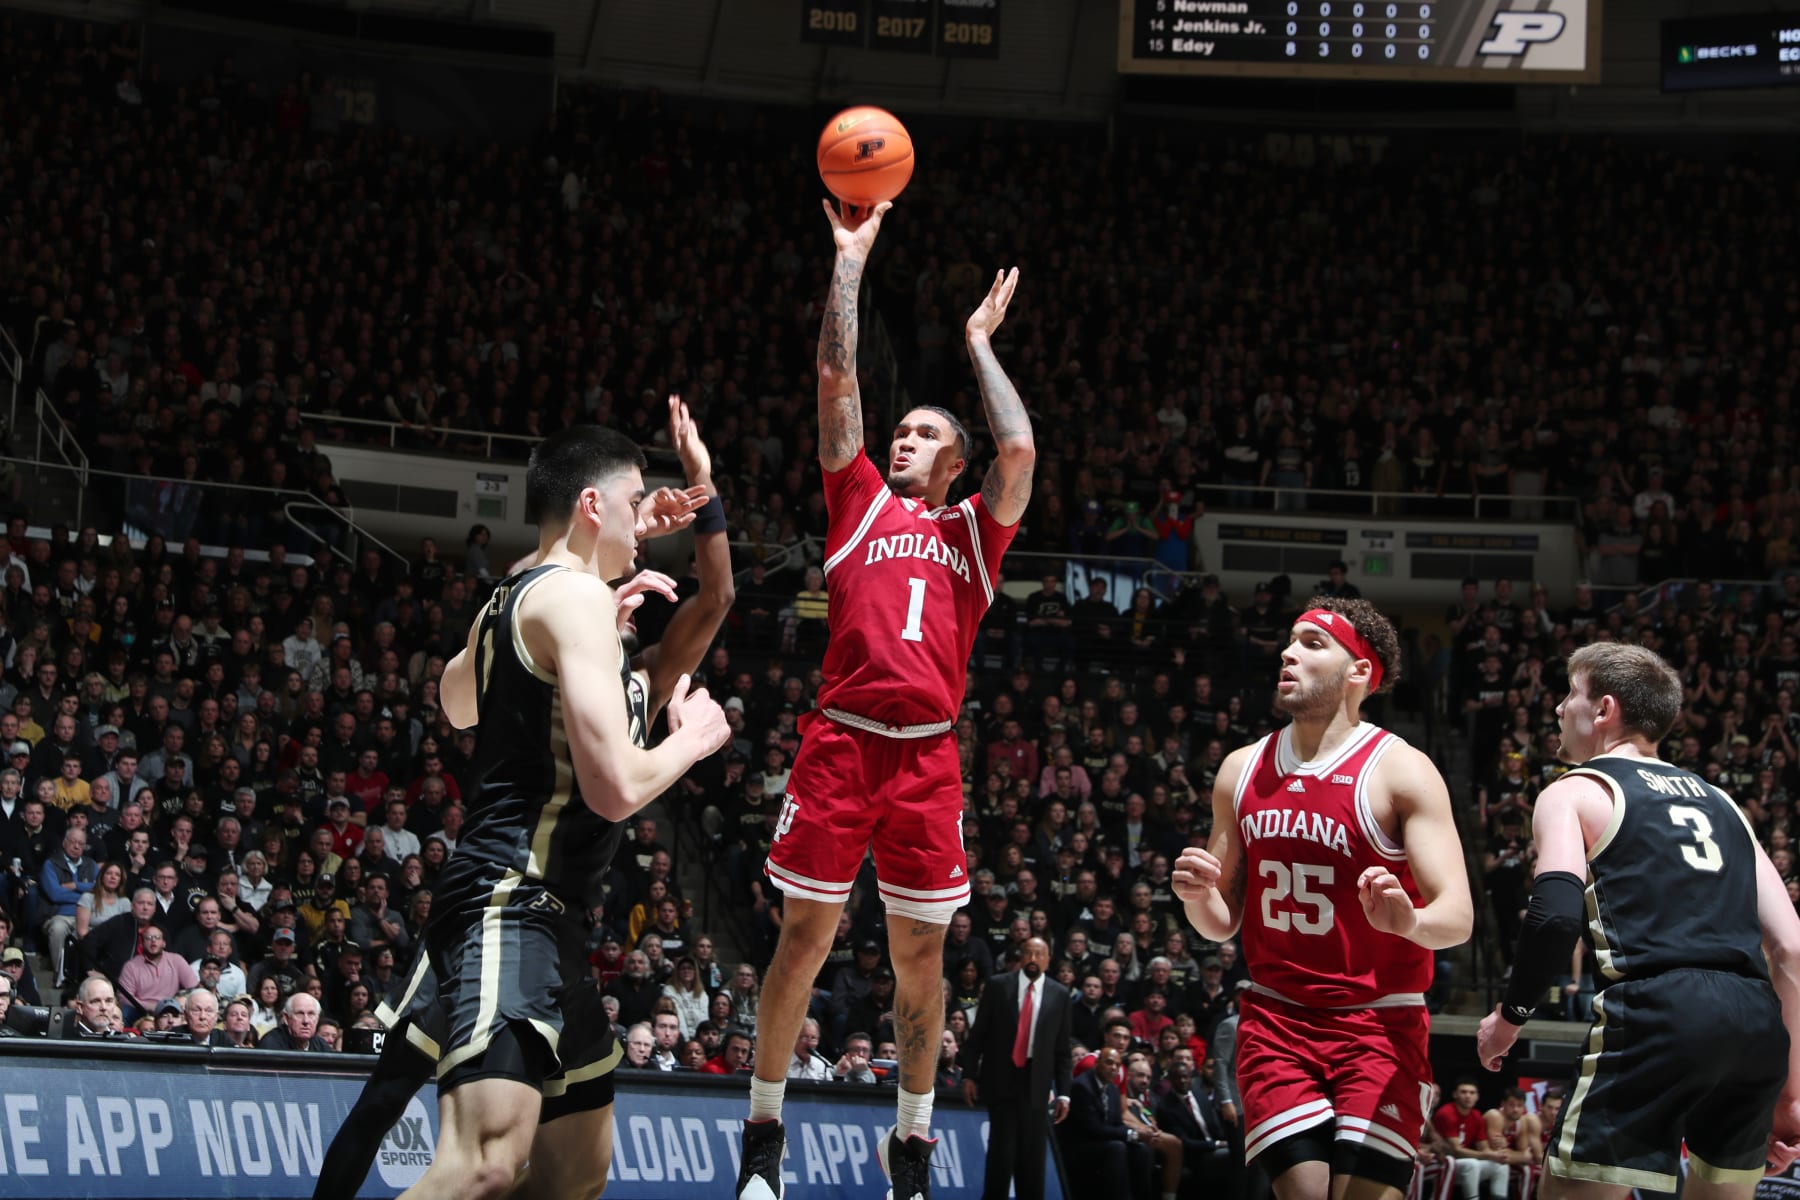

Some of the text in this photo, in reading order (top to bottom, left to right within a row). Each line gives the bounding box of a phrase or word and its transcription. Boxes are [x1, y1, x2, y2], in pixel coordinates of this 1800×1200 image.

[809, 8, 857, 31] 2010
[876, 16, 926, 38] 2017
[1174, 0, 1248, 13] Newman
[1287, 1, 1298, 16] 0
[1320, 2, 1331, 17] 0
[1353, 3, 1364, 18] 0
[1386, 4, 1397, 18] 0
[1419, 4, 1430, 19] 0
[943, 22, 993, 45] 2019
[1150, 18, 1430, 39] 14 Jenkins Jr. 0 0 0 0 0
[1478, 10, 1566, 55] P
[1149, 39, 1164, 51] 15
[1172, 38, 1215, 55] Edey
[1318, 42, 1329, 57] 3
[1352, 43, 1363, 58] 0
[1385, 44, 1396, 59] 0
[1418, 44, 1429, 59] 0
[865, 533, 970, 584] INDIANA
[901, 577, 927, 642] 1
[1637, 769, 1708, 797] SMITH
[1241, 809, 1351, 858] INDIANA
[1668, 805, 1723, 872] 3
[1258, 860, 1334, 936] 25
[0, 1093, 324, 1177] E APP NOW
[607, 1115, 715, 1182] LOAD
[801, 1122, 869, 1186] APP
[381, 1152, 433, 1166] SPORTS
